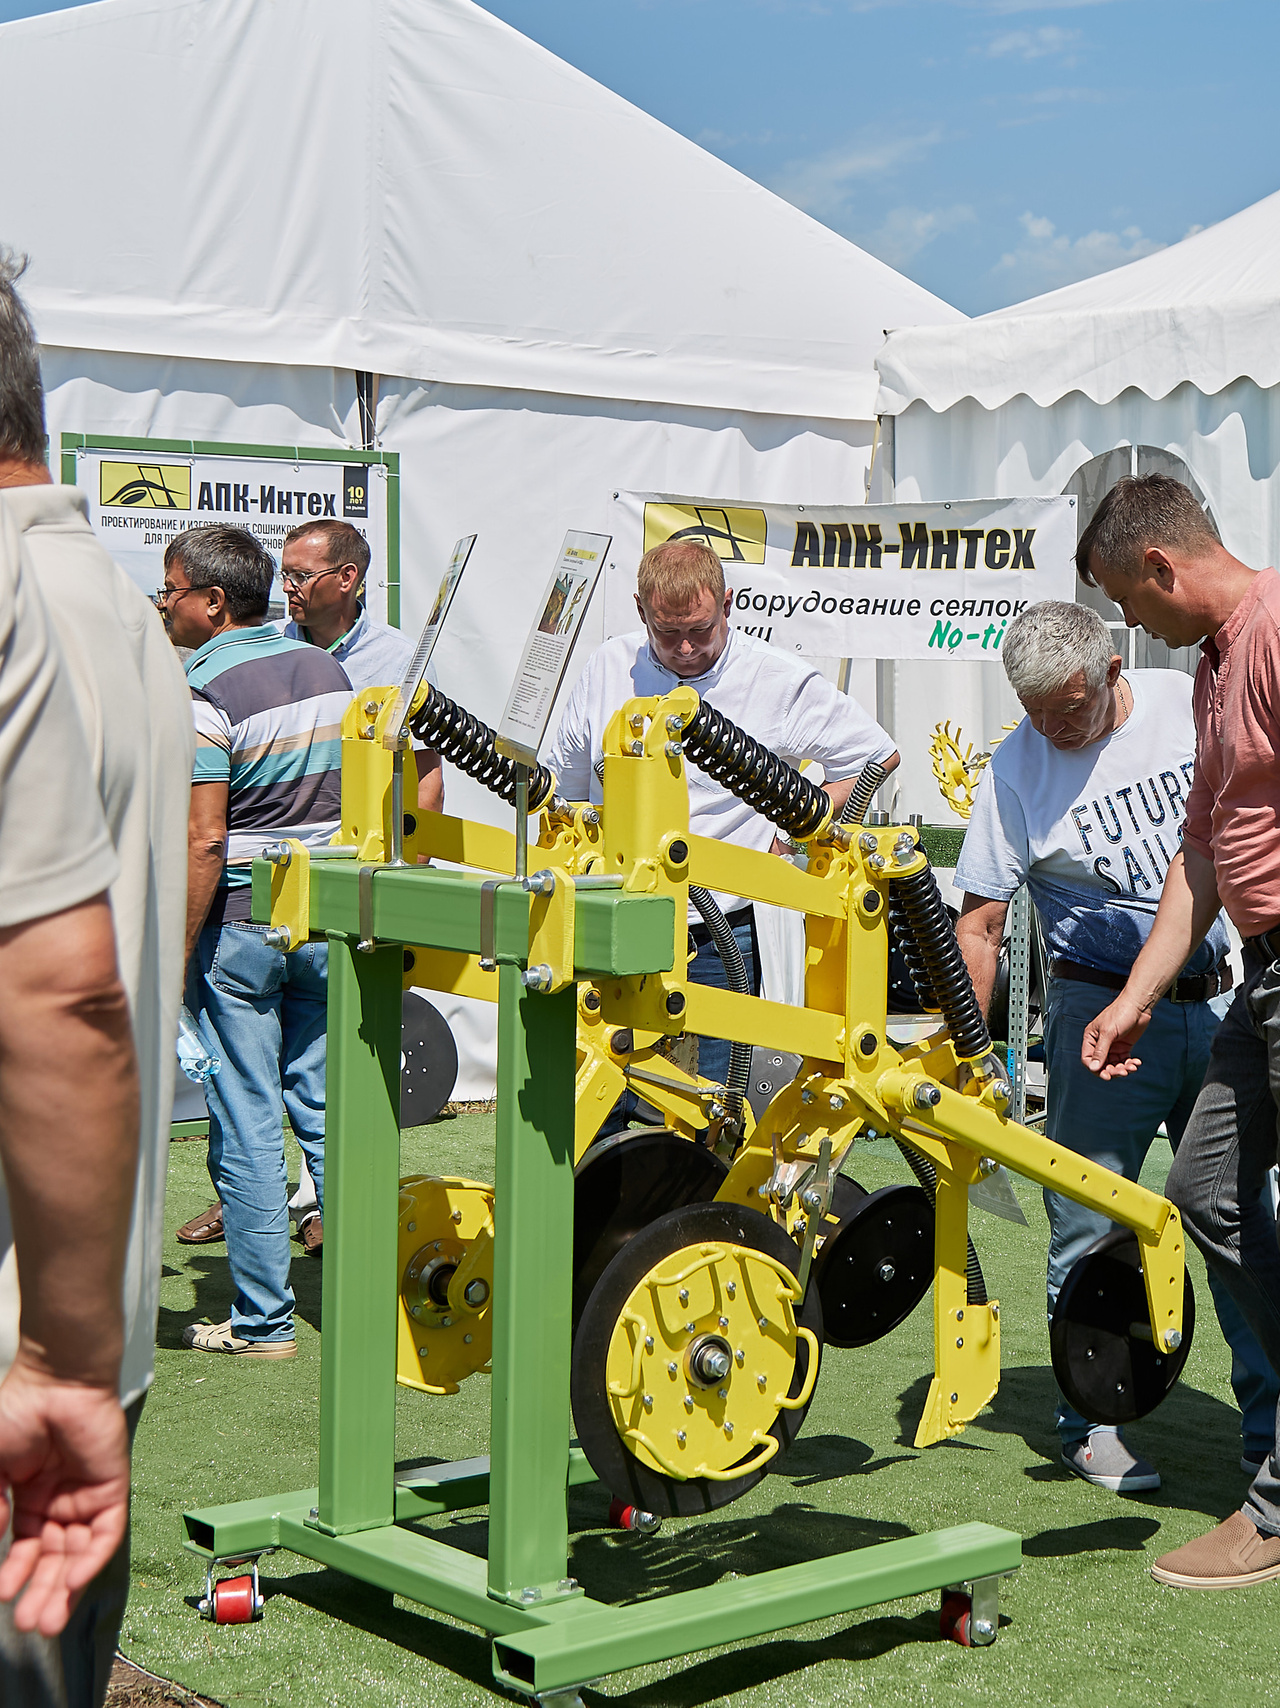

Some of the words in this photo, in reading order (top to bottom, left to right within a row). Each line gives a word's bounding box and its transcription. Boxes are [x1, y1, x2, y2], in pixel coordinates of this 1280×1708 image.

[198, 481, 336, 517] АПК-Интех
[347, 486, 364, 498] 10
[101, 515, 177, 531] ПРОЕКТИРОВАНИЕ
[180, 519, 186, 530] И
[144, 533, 162, 545] ДЛЯ
[790, 520, 1037, 571] АПК-Интех
[735, 588, 921, 618] борудование
[929, 598, 1028, 618] сеялок
[928, 619, 1007, 650] No-ti
